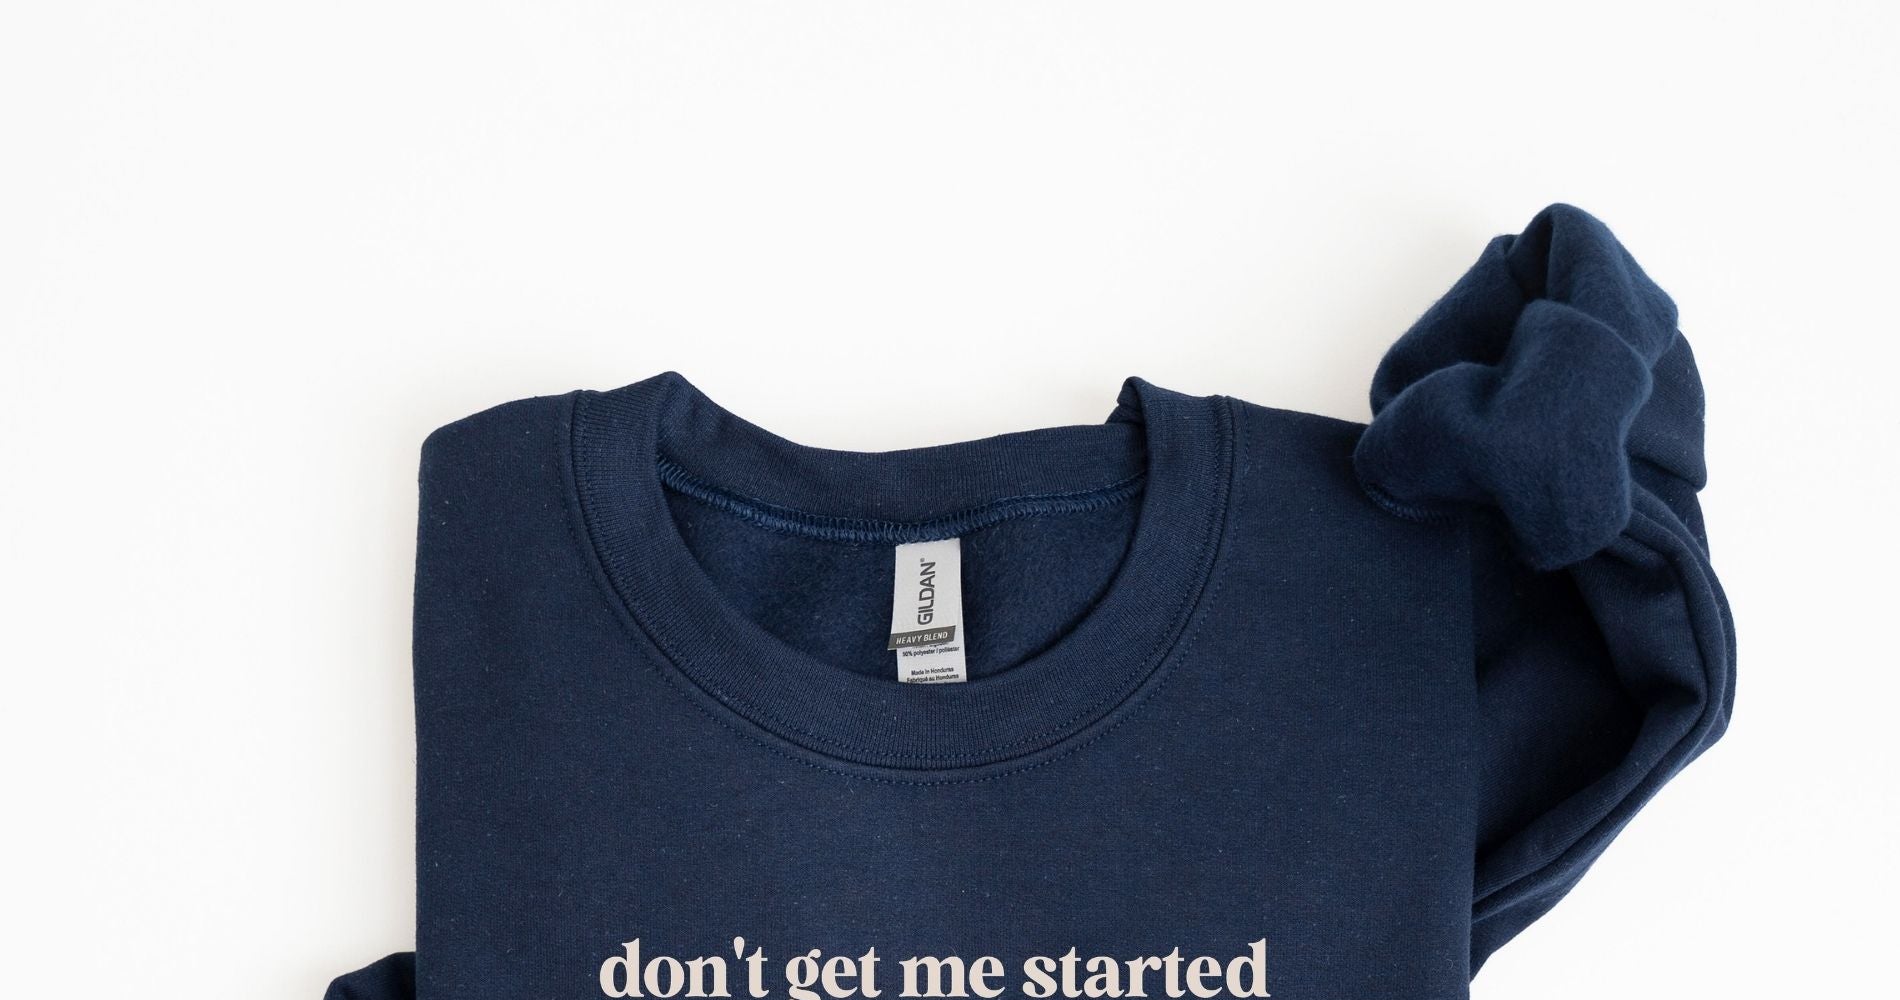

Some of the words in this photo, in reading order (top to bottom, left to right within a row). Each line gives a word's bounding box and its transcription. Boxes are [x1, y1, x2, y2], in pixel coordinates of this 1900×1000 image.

[896, 635, 922, 645] HEAVY
[923, 632, 948, 641] BLEND
[600, 937, 769, 998] don't
[899, 956, 1005, 998] me
[1023, 938, 1271, 998] started
